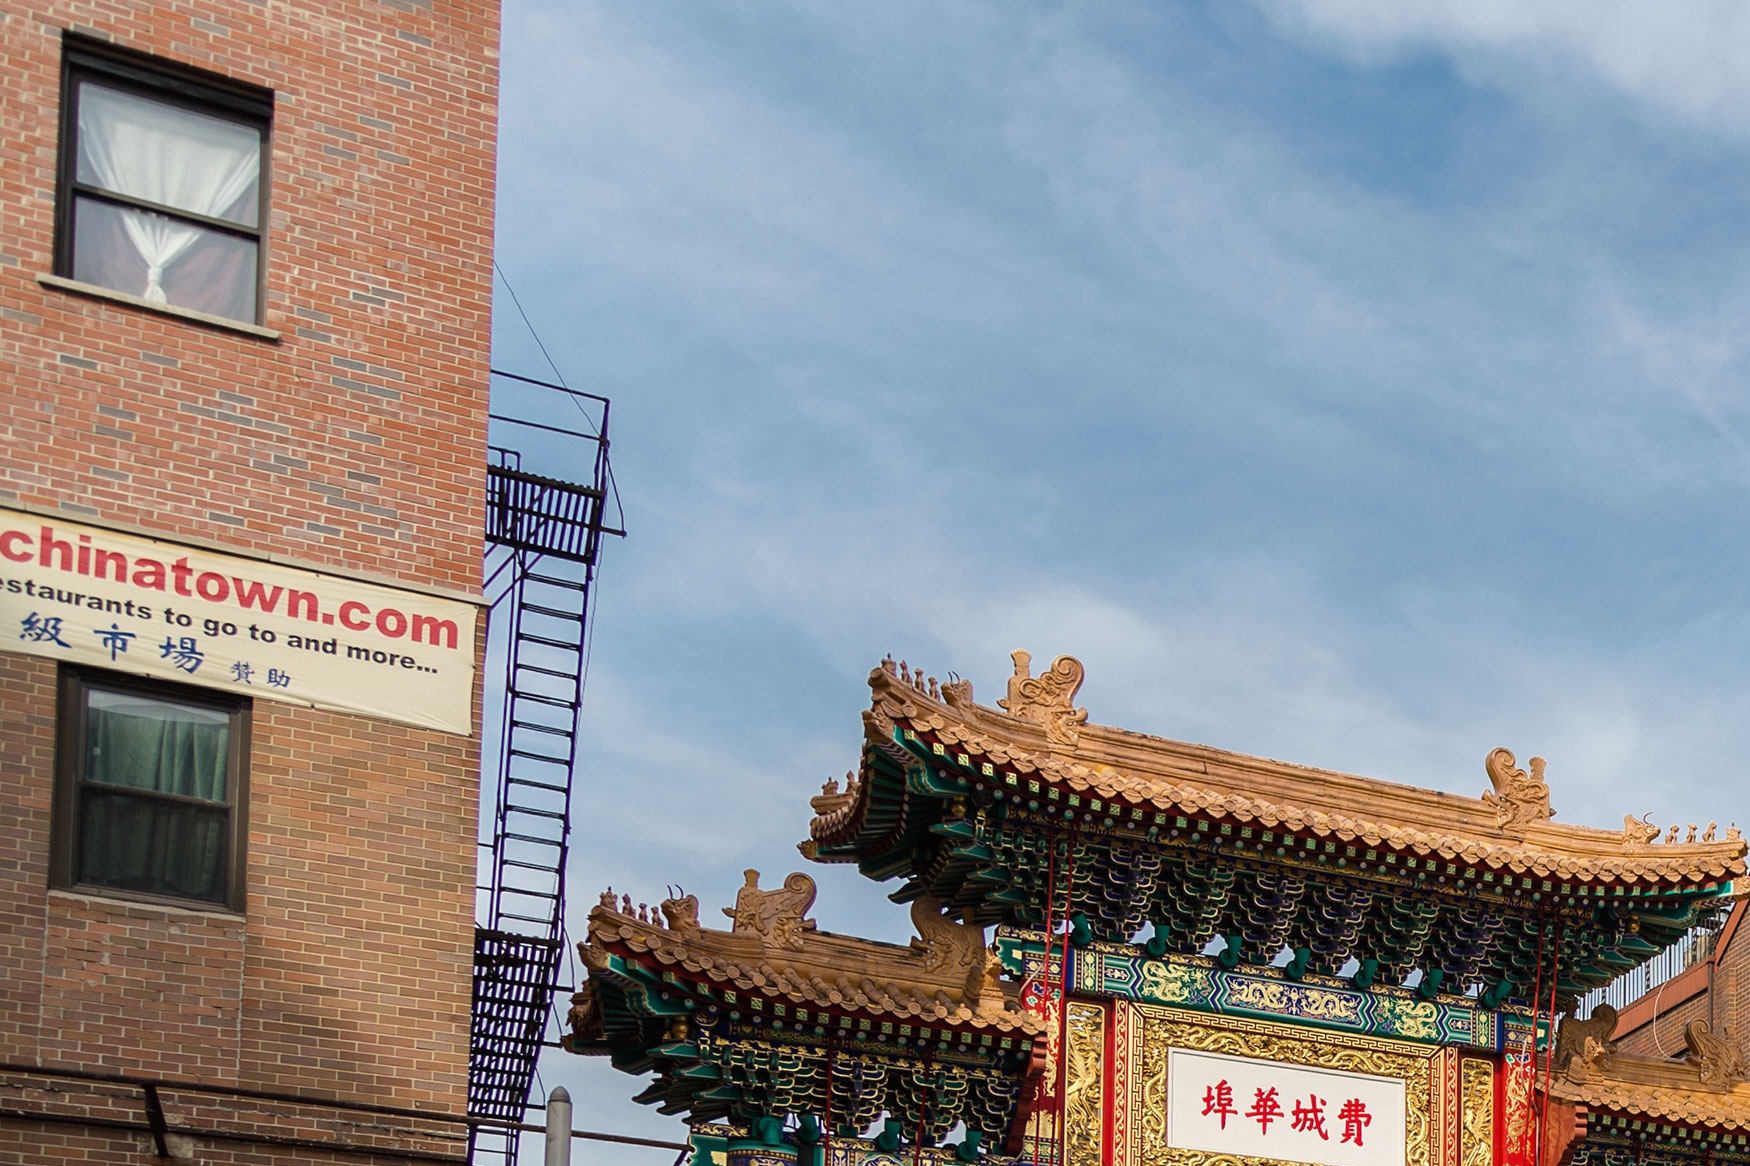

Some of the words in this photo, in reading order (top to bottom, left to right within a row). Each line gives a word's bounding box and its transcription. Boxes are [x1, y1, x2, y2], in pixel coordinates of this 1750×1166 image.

[0, 527, 458, 649] chinatown.com
[0, 578, 152, 619] staurants
[164, 607, 193, 627] to
[203, 617, 238, 637] go
[249, 623, 277, 644] to
[287, 632, 338, 655] and
[347, 645, 438, 674] more...
